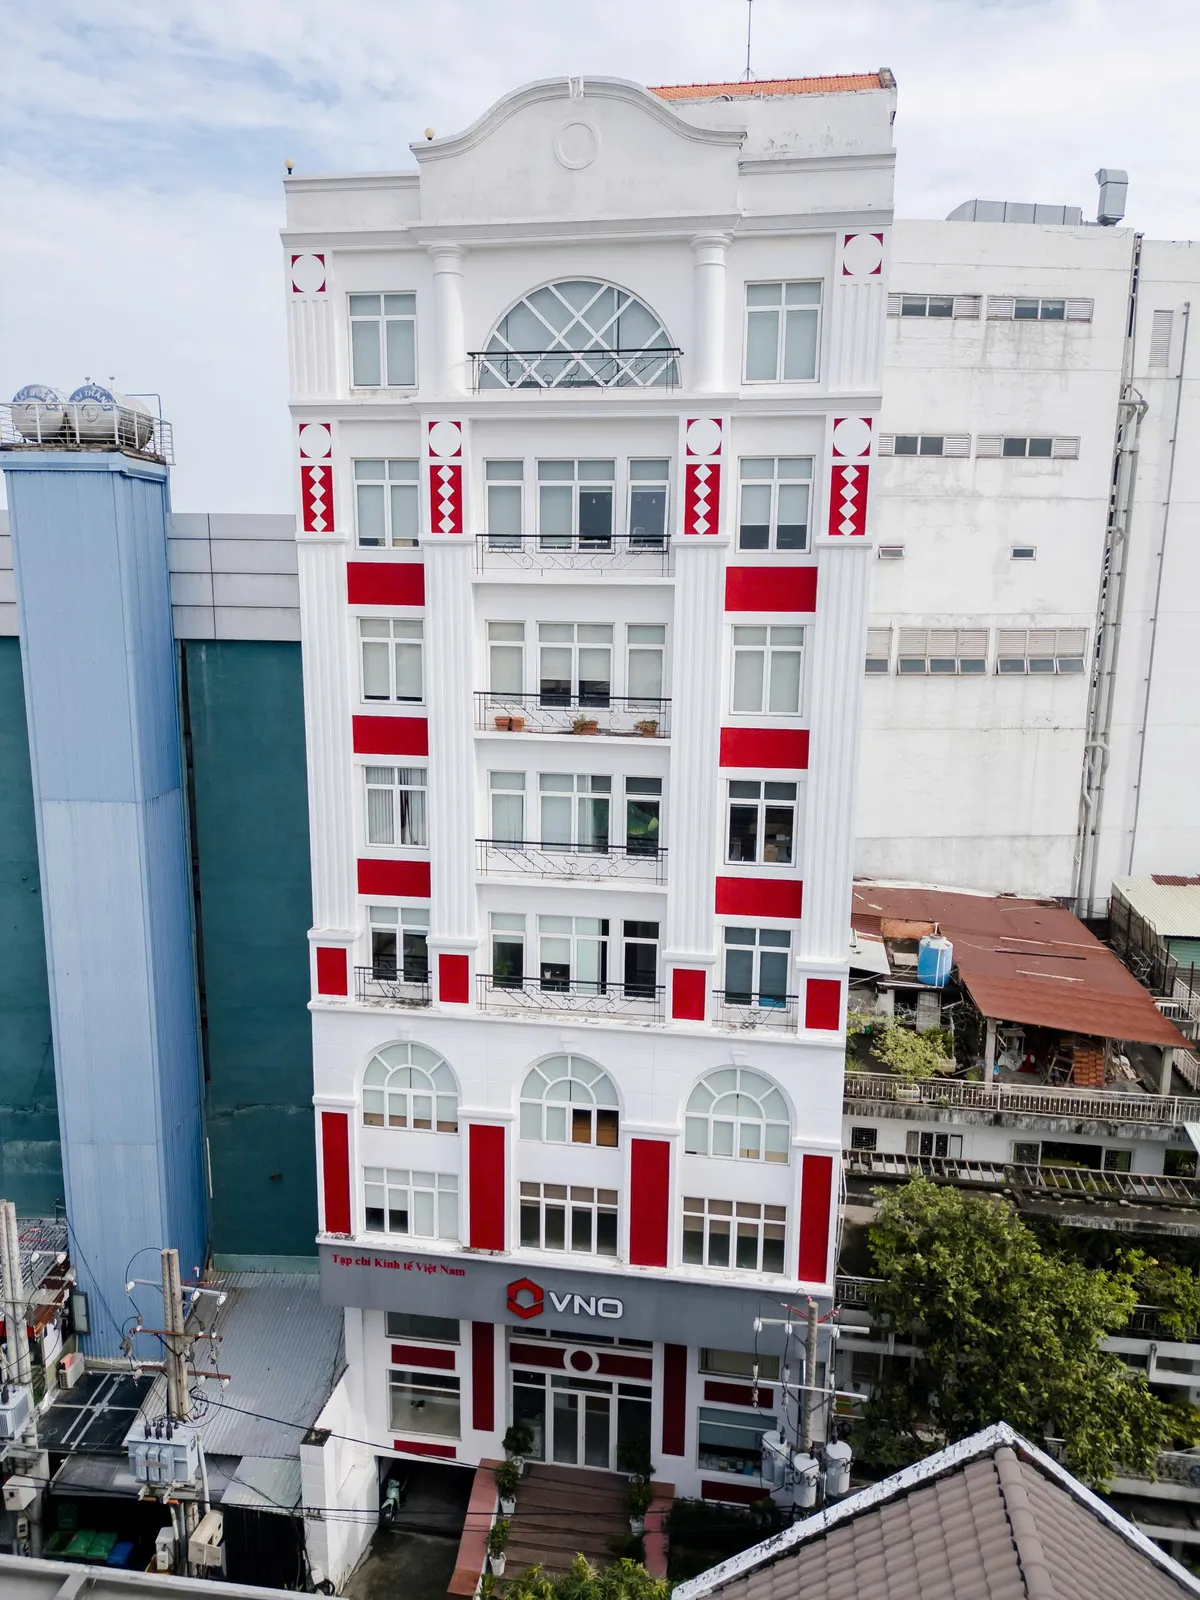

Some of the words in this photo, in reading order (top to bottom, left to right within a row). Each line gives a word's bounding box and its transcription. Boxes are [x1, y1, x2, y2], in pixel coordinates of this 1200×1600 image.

[332, 1253, 352, 1267] Tạp
[355, 1256, 371, 1267] chí
[374, 1258, 400, 1270] Kinh
[403, 1260, 414, 1271] tế
[416, 1262, 437, 1275] Việt
[440, 1264, 466, 1277] Nam
[548, 1291, 624, 1319] VNO
